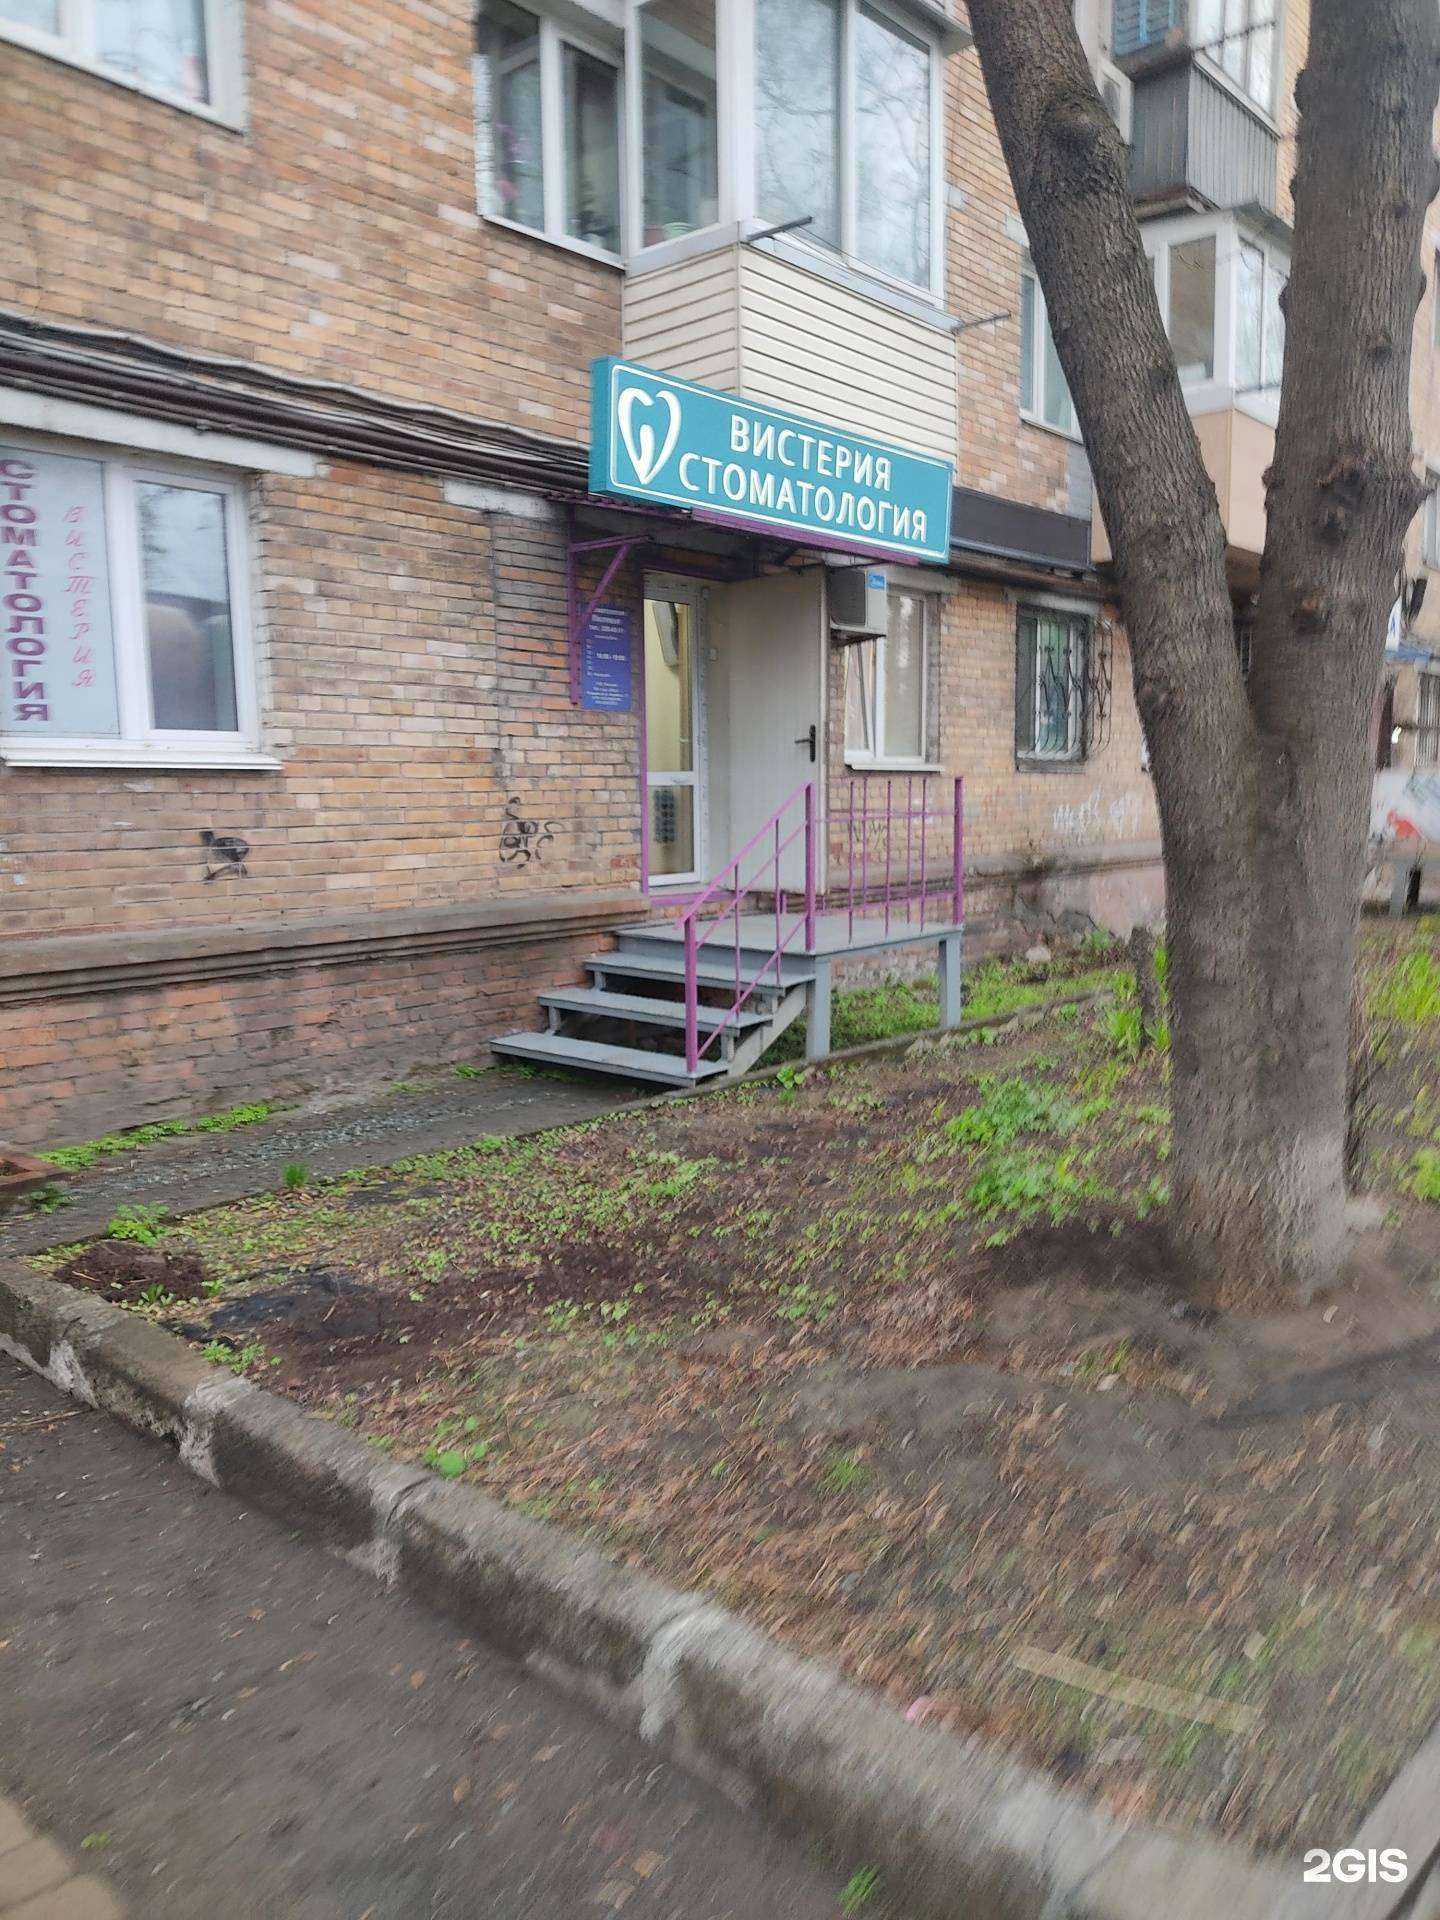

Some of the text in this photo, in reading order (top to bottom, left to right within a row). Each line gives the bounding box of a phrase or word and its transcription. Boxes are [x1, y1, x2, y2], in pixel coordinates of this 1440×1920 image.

[731, 414, 891, 491] ВИСТЕРИЯ
[678, 453, 927, 544] СТОМАТОЛОГИЯ
[0, 459, 48, 721] СТОМАТОЛОГИЯ
